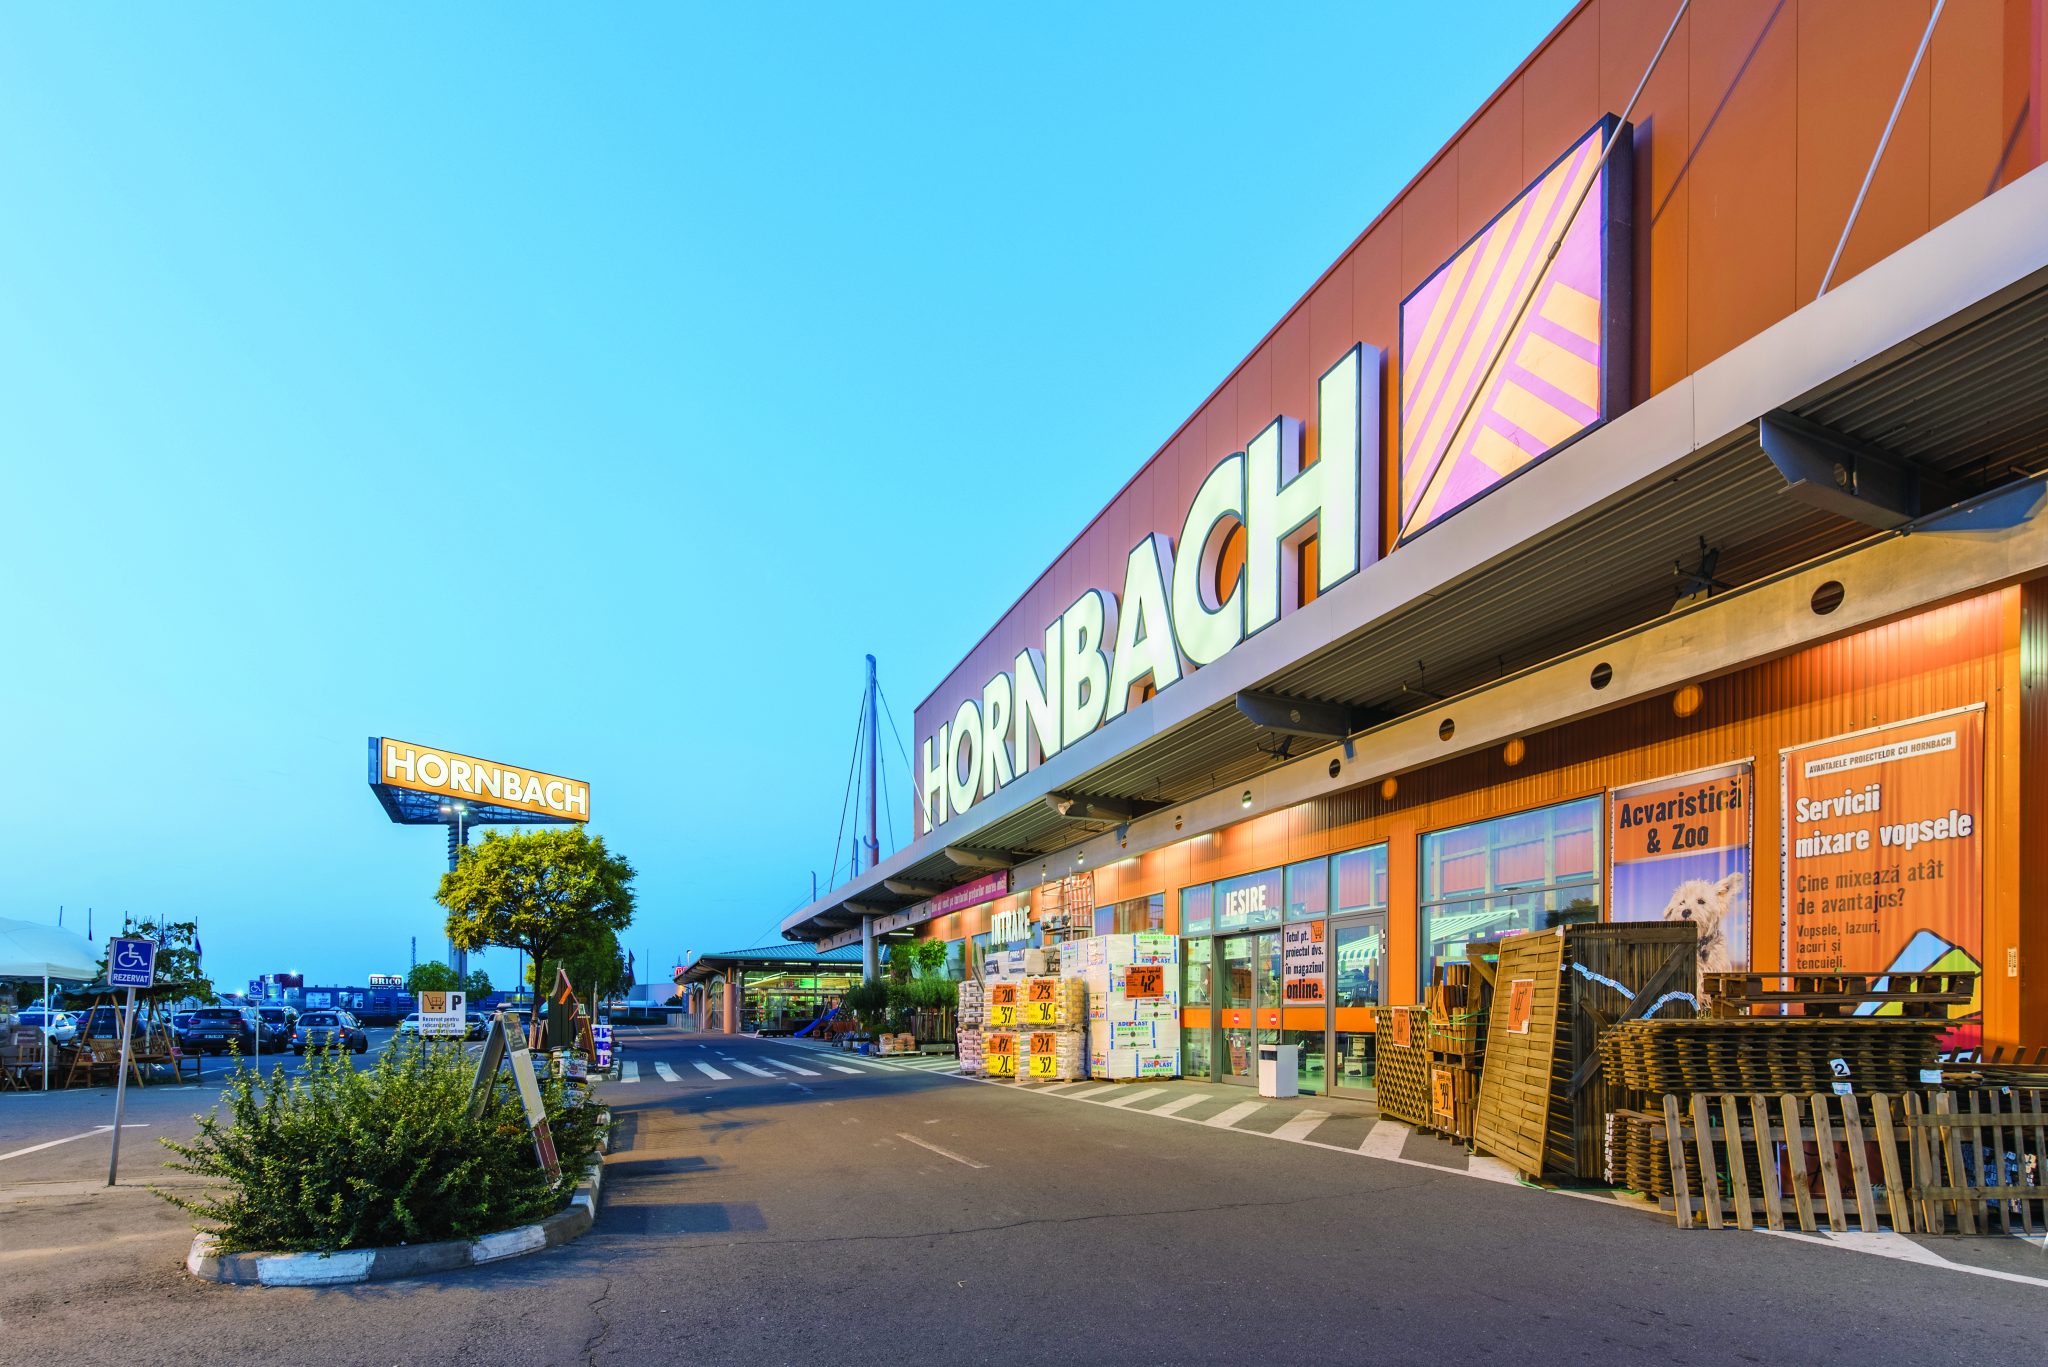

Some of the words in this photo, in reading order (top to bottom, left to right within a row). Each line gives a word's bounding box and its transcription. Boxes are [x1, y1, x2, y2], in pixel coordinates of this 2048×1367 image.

[923, 341, 1364, 835] HORNBACH
[1808, 759, 1848, 774] AVANTAJELE
[1849, 748, 1896, 766] PROIECTELOR
[1897, 746, 1908, 756] CU
[1910, 736, 1952, 753] HORNBACH
[386, 744, 587, 815] HORNBACH
[1619, 778, 1742, 829] Acvaristică
[1795, 783, 1881, 823] Servicii
[1646, 828, 1662, 853] &
[1672, 823, 1709, 850] Zoo
[1795, 829, 1870, 858] mixare
[1879, 809, 1974, 851] vopsele
[1796, 875, 1829, 893] Cine
[1835, 864, 1900, 888] mixează
[1907, 859, 1944, 881] atât
[1796, 898, 1815, 915] de
[1821, 887, 1906, 914] avantajos?
[991, 905, 1031, 946] INTRARE
[1796, 923, 1841, 940] Vopsele,
[1845, 919, 1881, 935] lazuri,
[1286, 930, 1300, 943] Totul
[1300, 931, 1309, 944] pt.
[1796, 940, 1827, 954] lacuri
[1831, 938, 1841, 956] și
[1285, 945, 1310, 960] proiectul
[1311, 945, 1324, 956] dvs.
[1796, 956, 1846, 969] tencuieli.
[113, 973, 149, 983] REZERVAT
[1285, 963, 1291, 975] în
[1293, 961, 1324, 977] magazinul
[371, 977, 401, 985] BRICO
[1286, 978, 1323, 999] online.
[452, 995, 462, 1010] P
[1036, 984, 1051, 1000] 23
[1834, 1063, 1848, 1076] 2
